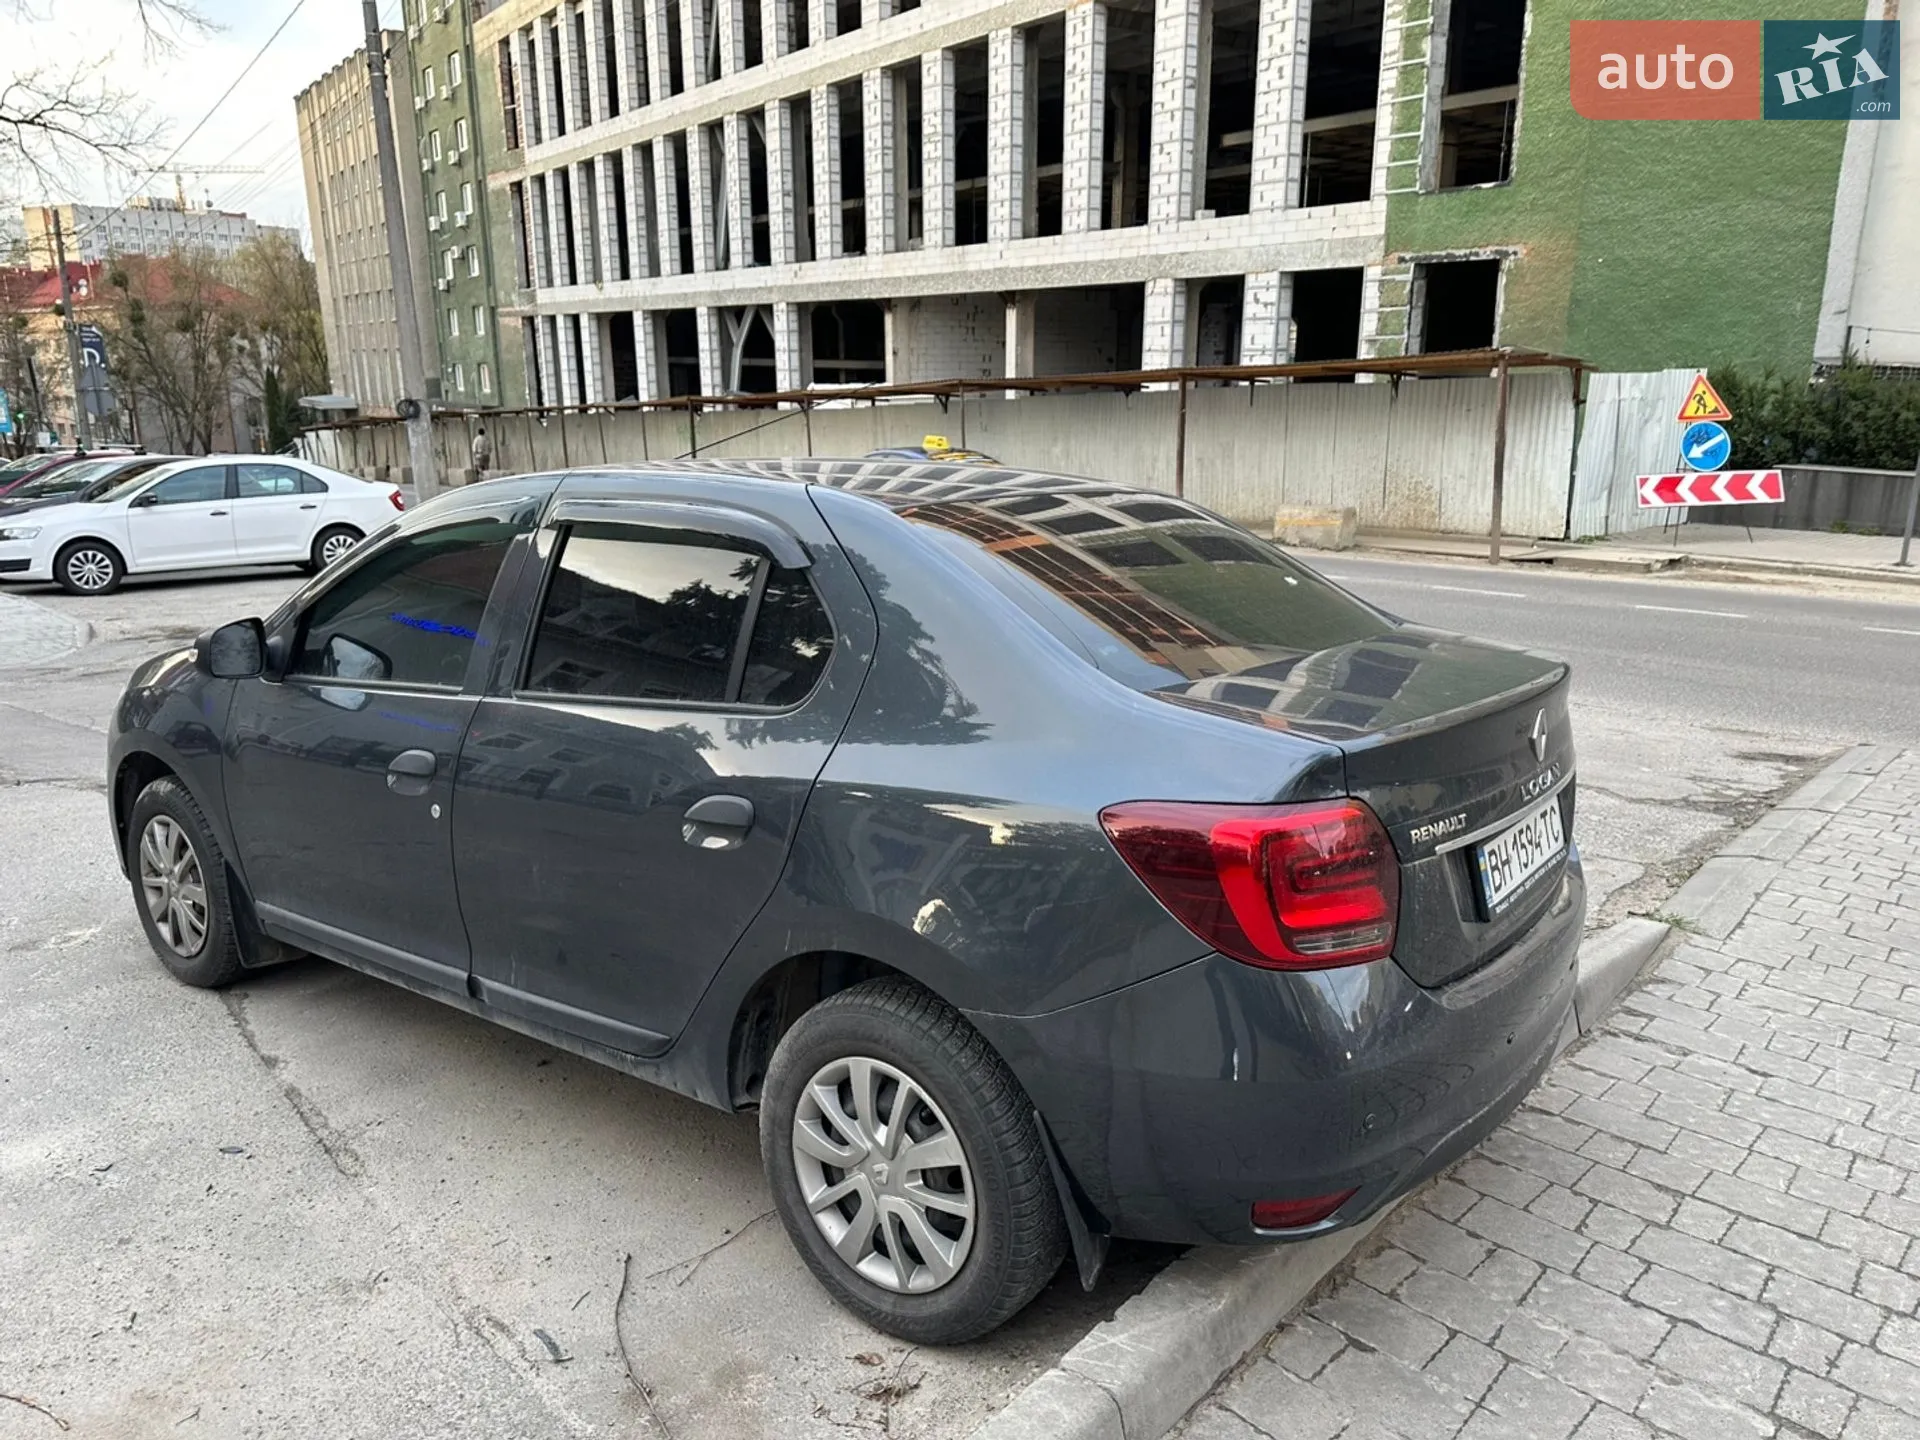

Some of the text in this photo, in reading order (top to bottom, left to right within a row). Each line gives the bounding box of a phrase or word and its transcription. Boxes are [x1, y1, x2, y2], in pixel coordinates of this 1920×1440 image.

[1520, 762, 1561, 801] LOGAN
[1410, 812, 1467, 845] RENAULT
[1488, 839, 1513, 893] BH
[1512, 816, 1543, 874] 1594
[1540, 804, 1560, 850] TC
